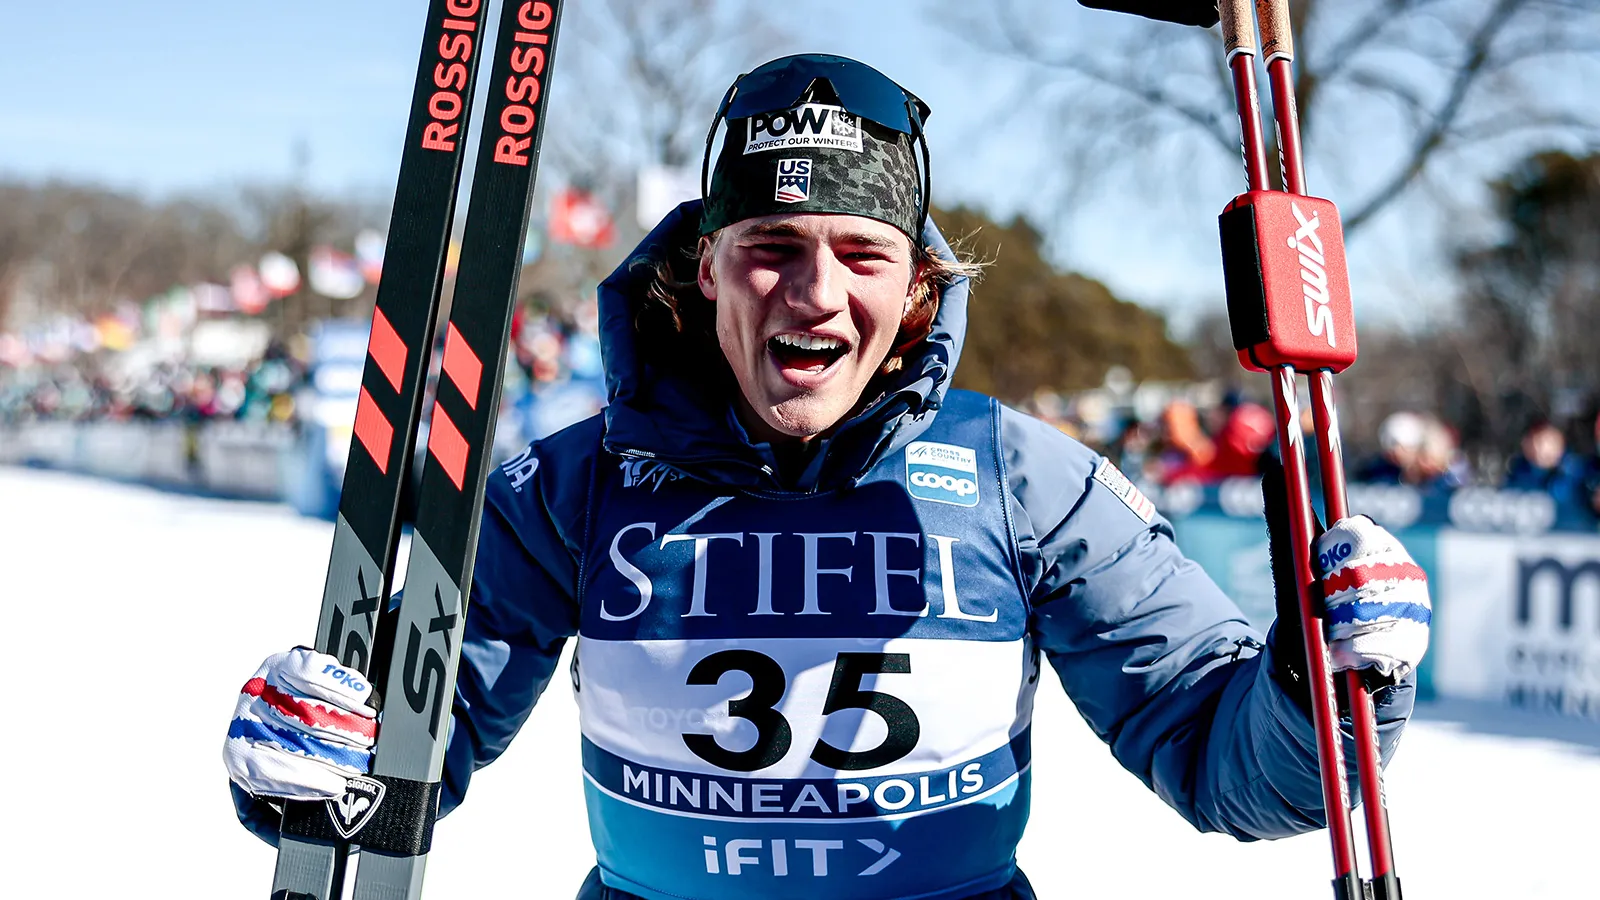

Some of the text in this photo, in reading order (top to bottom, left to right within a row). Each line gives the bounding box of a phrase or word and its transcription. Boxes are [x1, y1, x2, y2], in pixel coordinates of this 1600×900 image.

[751, 108, 830, 141] POW
[748, 139, 786, 151] PROTECT
[813, 138, 858, 149] WINTERS
[779, 161, 809, 174] US
[930, 446, 960, 456] CROSS
[930, 451, 972, 463] COUNTRY
[910, 471, 977, 497] coop
[599, 522, 998, 623] STIFEL
[321, 664, 366, 692] TOKO
[682, 649, 921, 771] 35
[623, 763, 984, 813] MINNEAPOLIS
